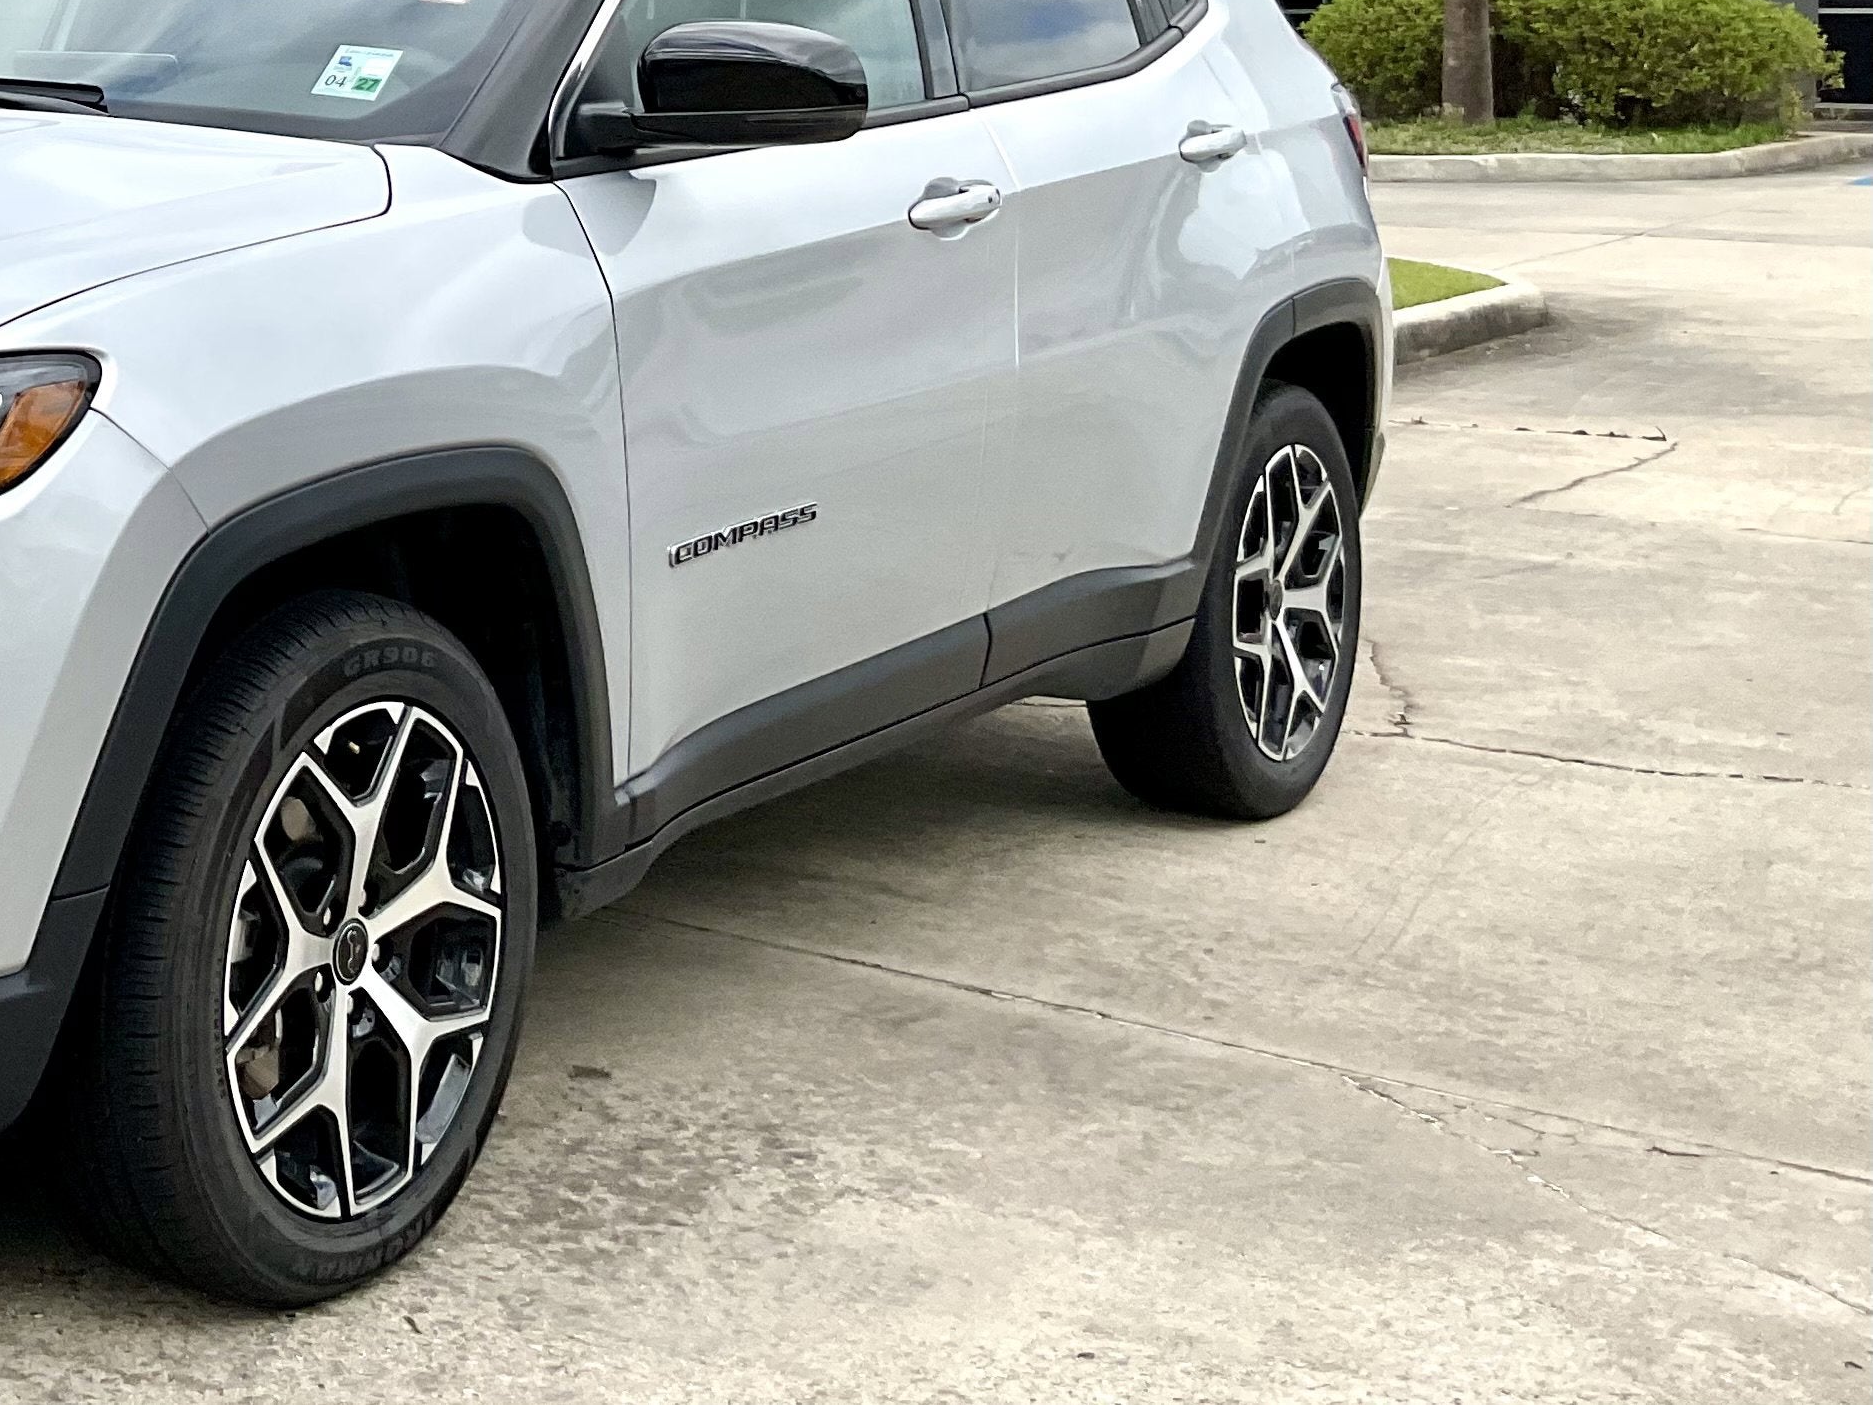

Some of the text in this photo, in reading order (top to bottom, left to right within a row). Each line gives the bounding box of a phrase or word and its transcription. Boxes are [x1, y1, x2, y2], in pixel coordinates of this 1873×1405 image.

[324, 75, 382, 91] 04 27
[669, 502, 818, 568] COMPASS
